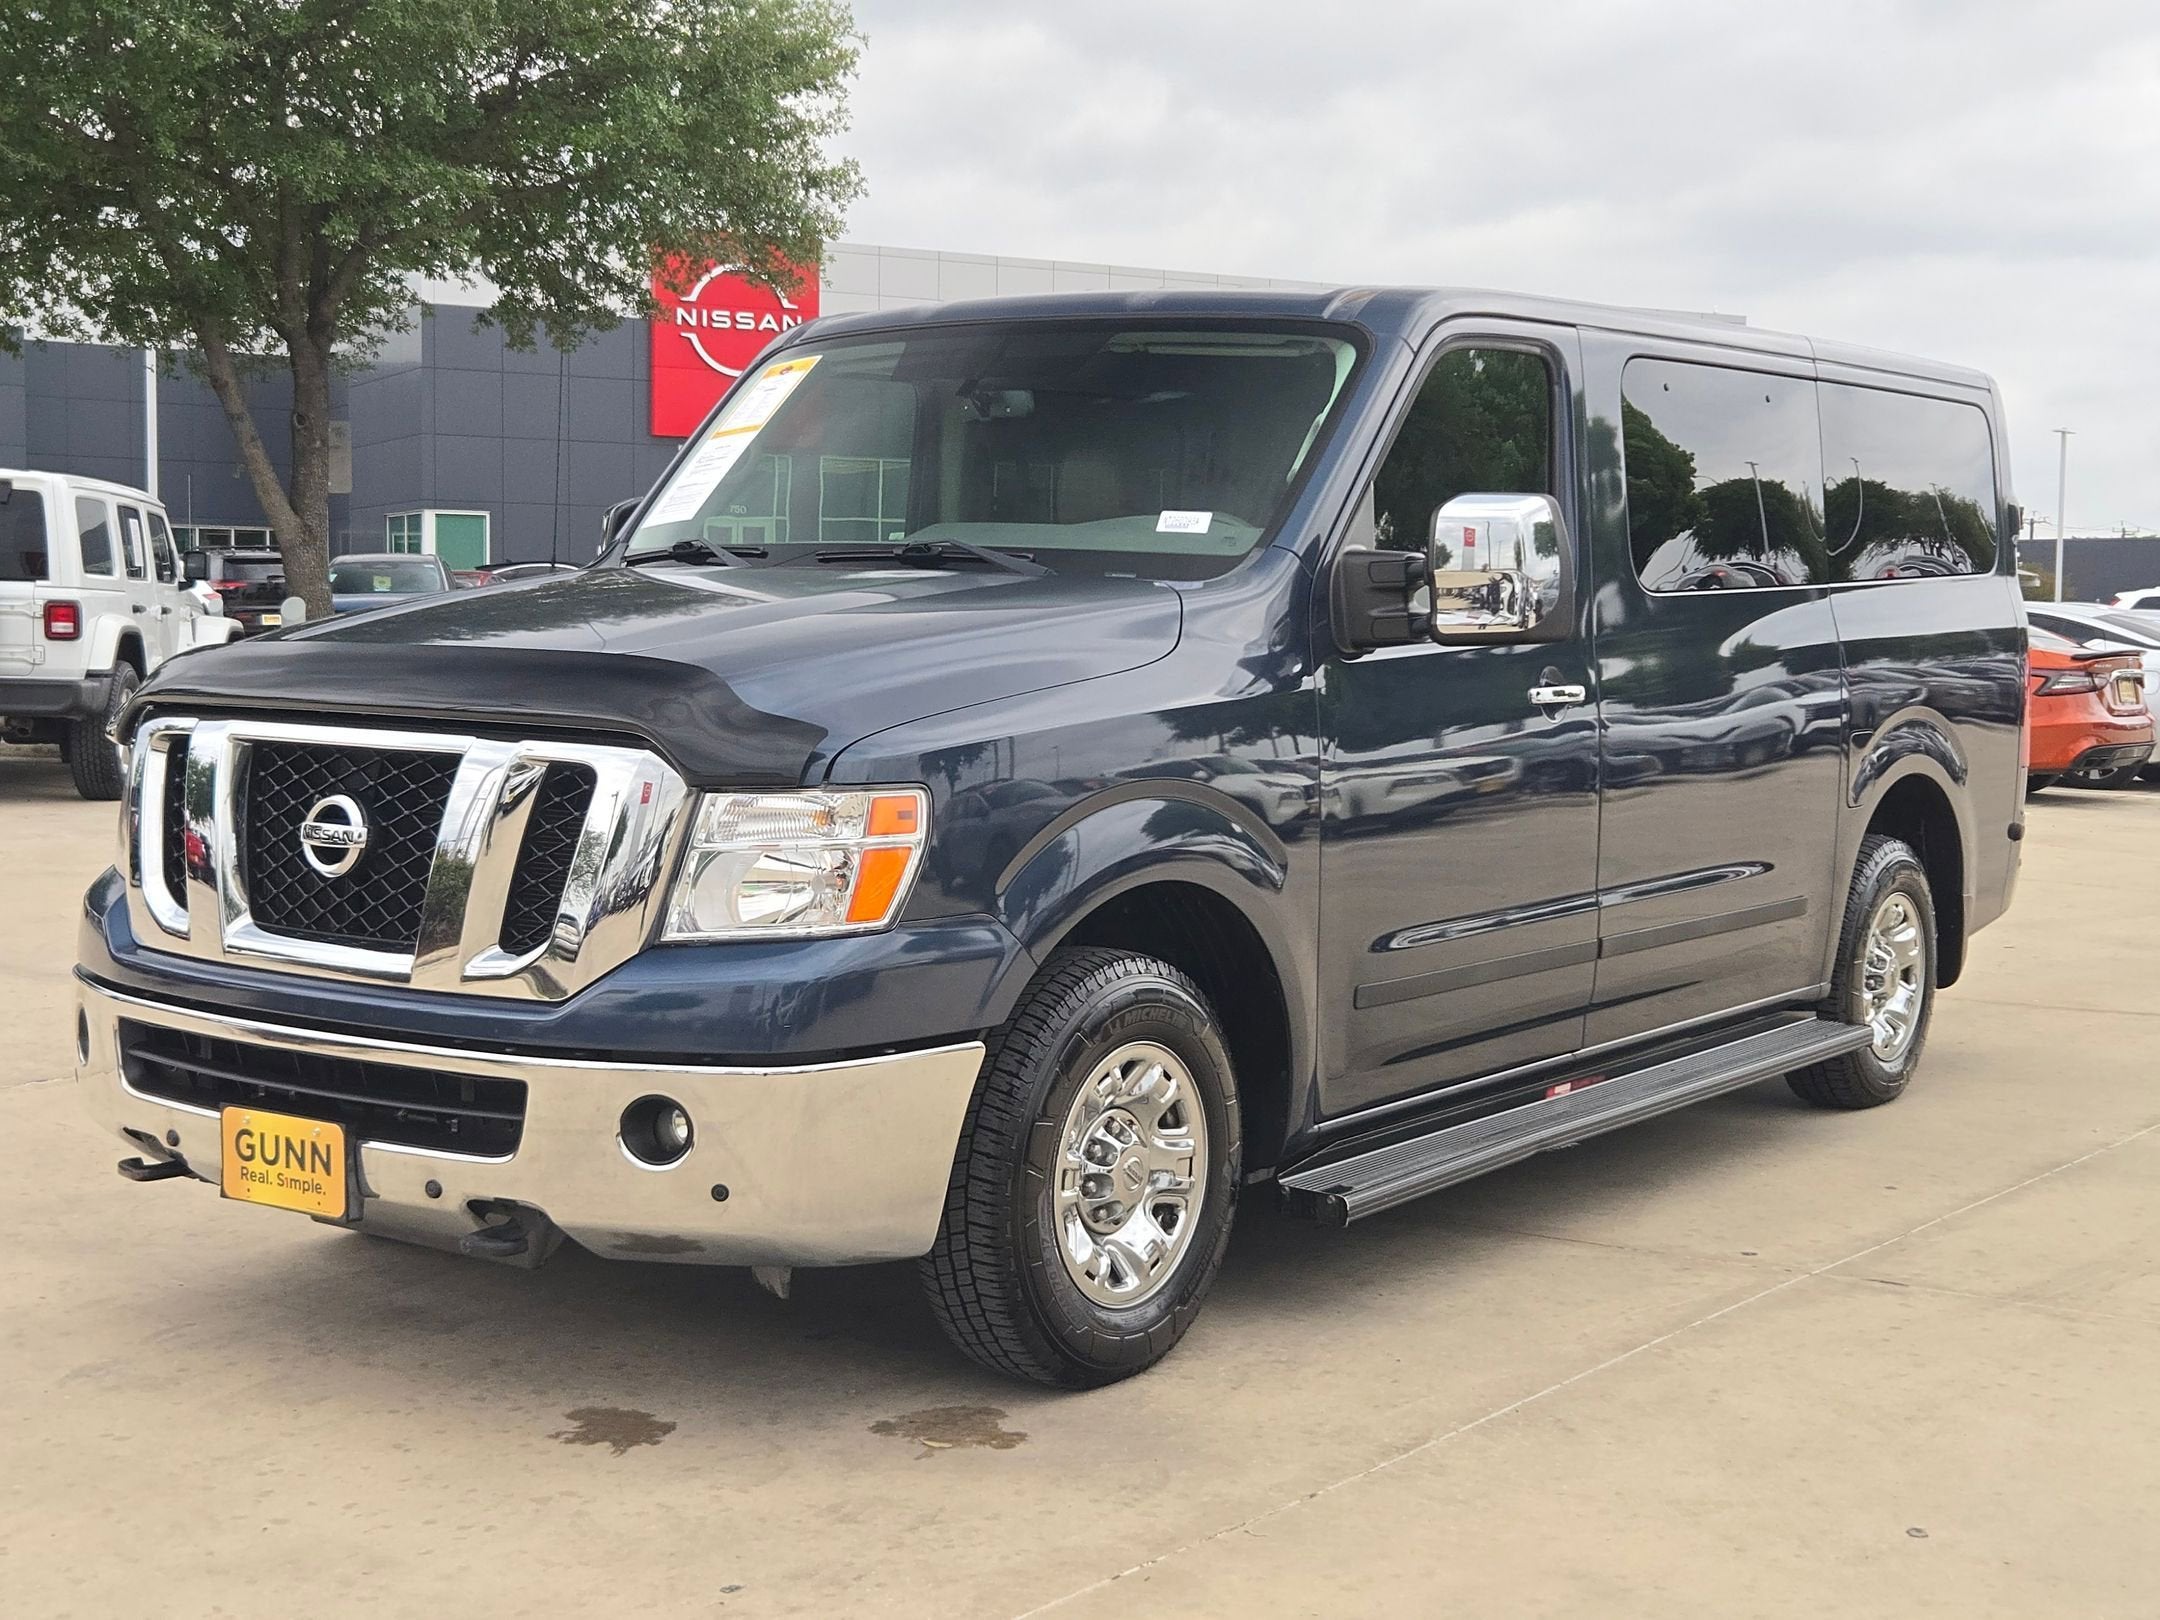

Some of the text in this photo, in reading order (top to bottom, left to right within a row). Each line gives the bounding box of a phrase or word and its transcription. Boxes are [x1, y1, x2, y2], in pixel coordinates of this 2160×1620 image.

[676, 307, 802, 332] NISSAN
[304, 824, 354, 843] NISSAN
[235, 1128, 332, 1177] GUNN
[240, 1166, 273, 1185] Real.
